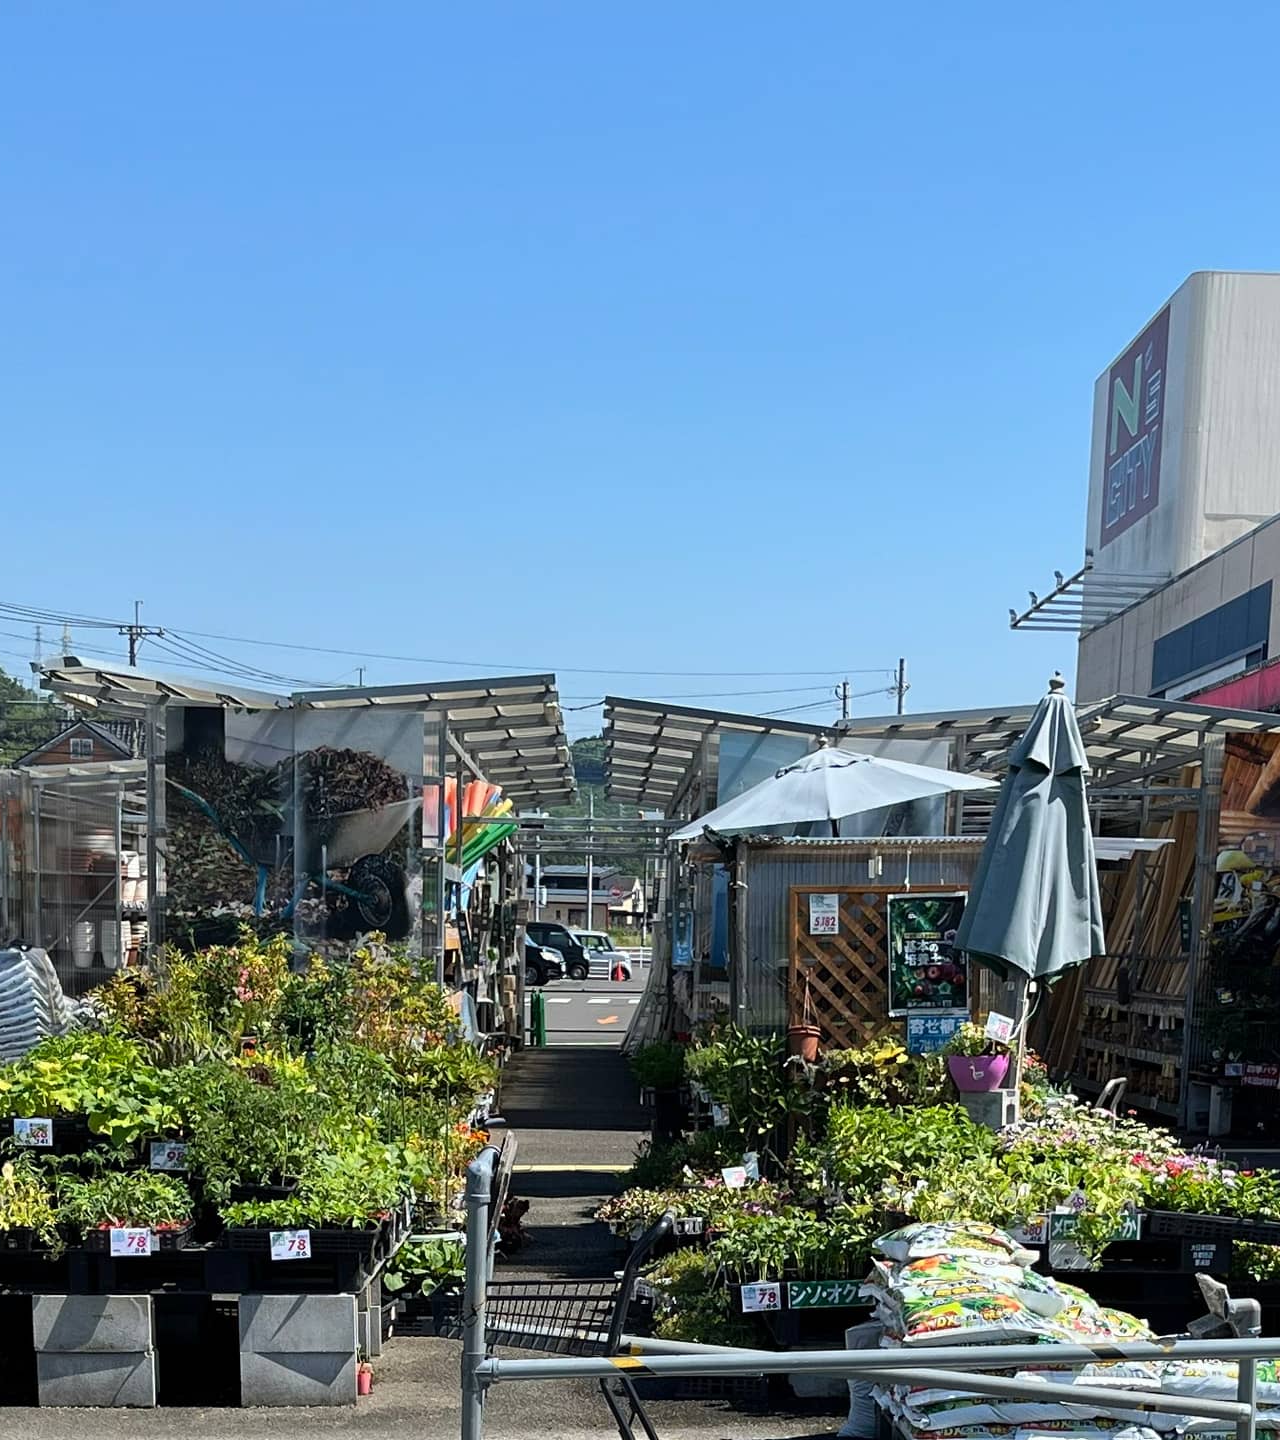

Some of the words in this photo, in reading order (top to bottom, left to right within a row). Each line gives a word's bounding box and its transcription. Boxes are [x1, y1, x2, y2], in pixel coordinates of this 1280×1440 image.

[1105, 424, 1159, 529] CITY
[127, 1236, 147, 1248] 78
[288, 1239, 307, 1251] 78
[758, 1291, 777, 1304] 78
